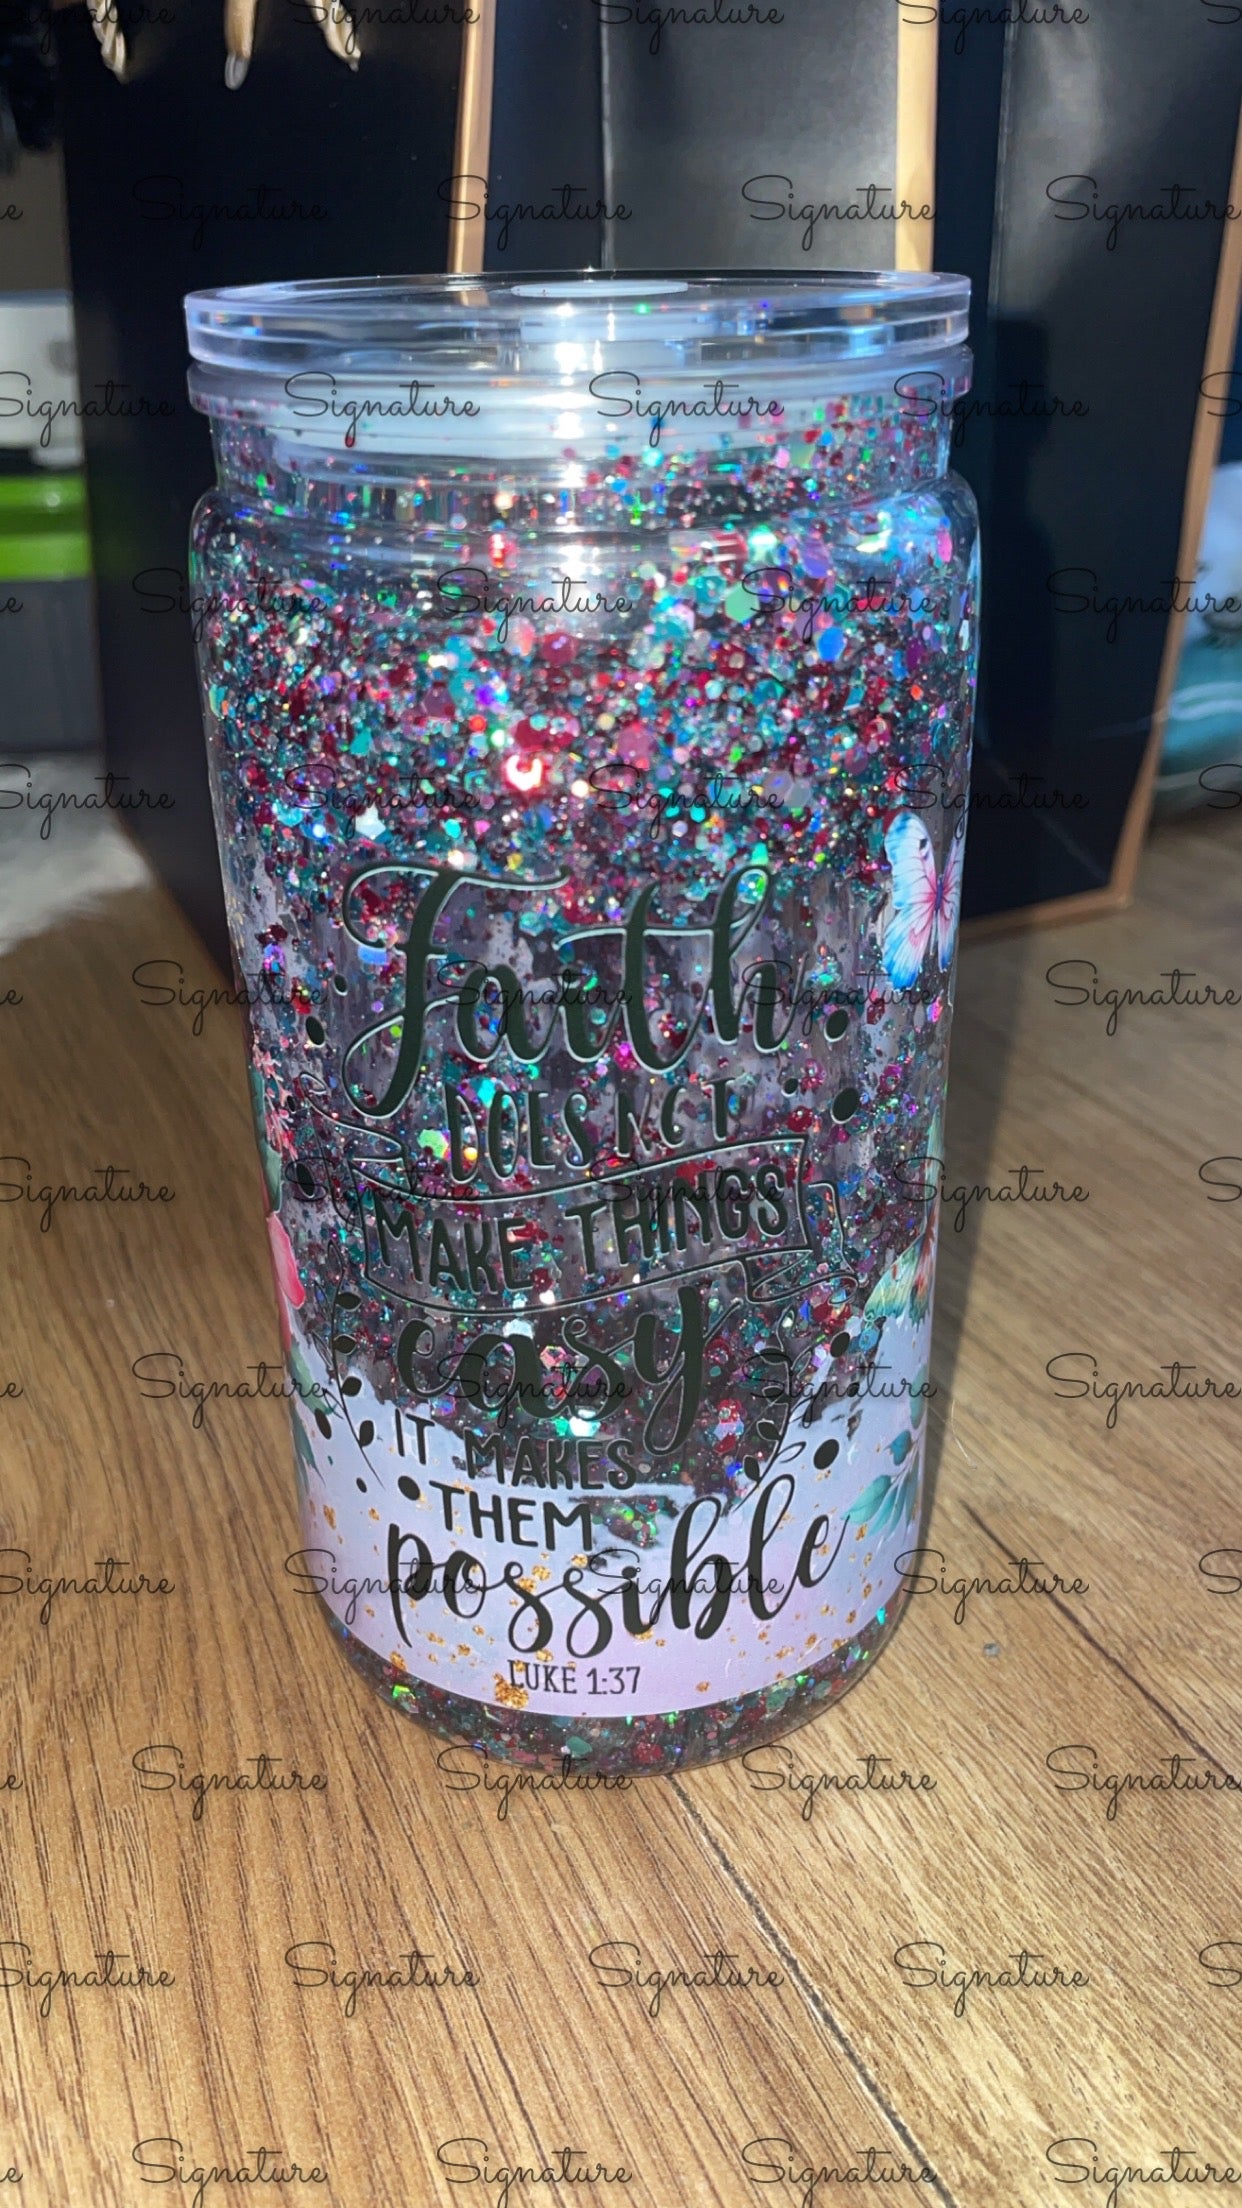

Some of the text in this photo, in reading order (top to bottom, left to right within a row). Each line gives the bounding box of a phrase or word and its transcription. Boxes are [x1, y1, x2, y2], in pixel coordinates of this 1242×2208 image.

[342, 864, 808, 1119] Faith
[445, 1082, 595, 1184] DOES
[374, 1166, 789, 1294] MAKE THINGS
[399, 1284, 740, 1455] easy
[394, 1409, 637, 1490] IT MAKES
[387, 1473, 849, 1659] possible
[429, 1480, 592, 1551] THEM
[507, 1660, 641, 1696] LUKE 1:37
